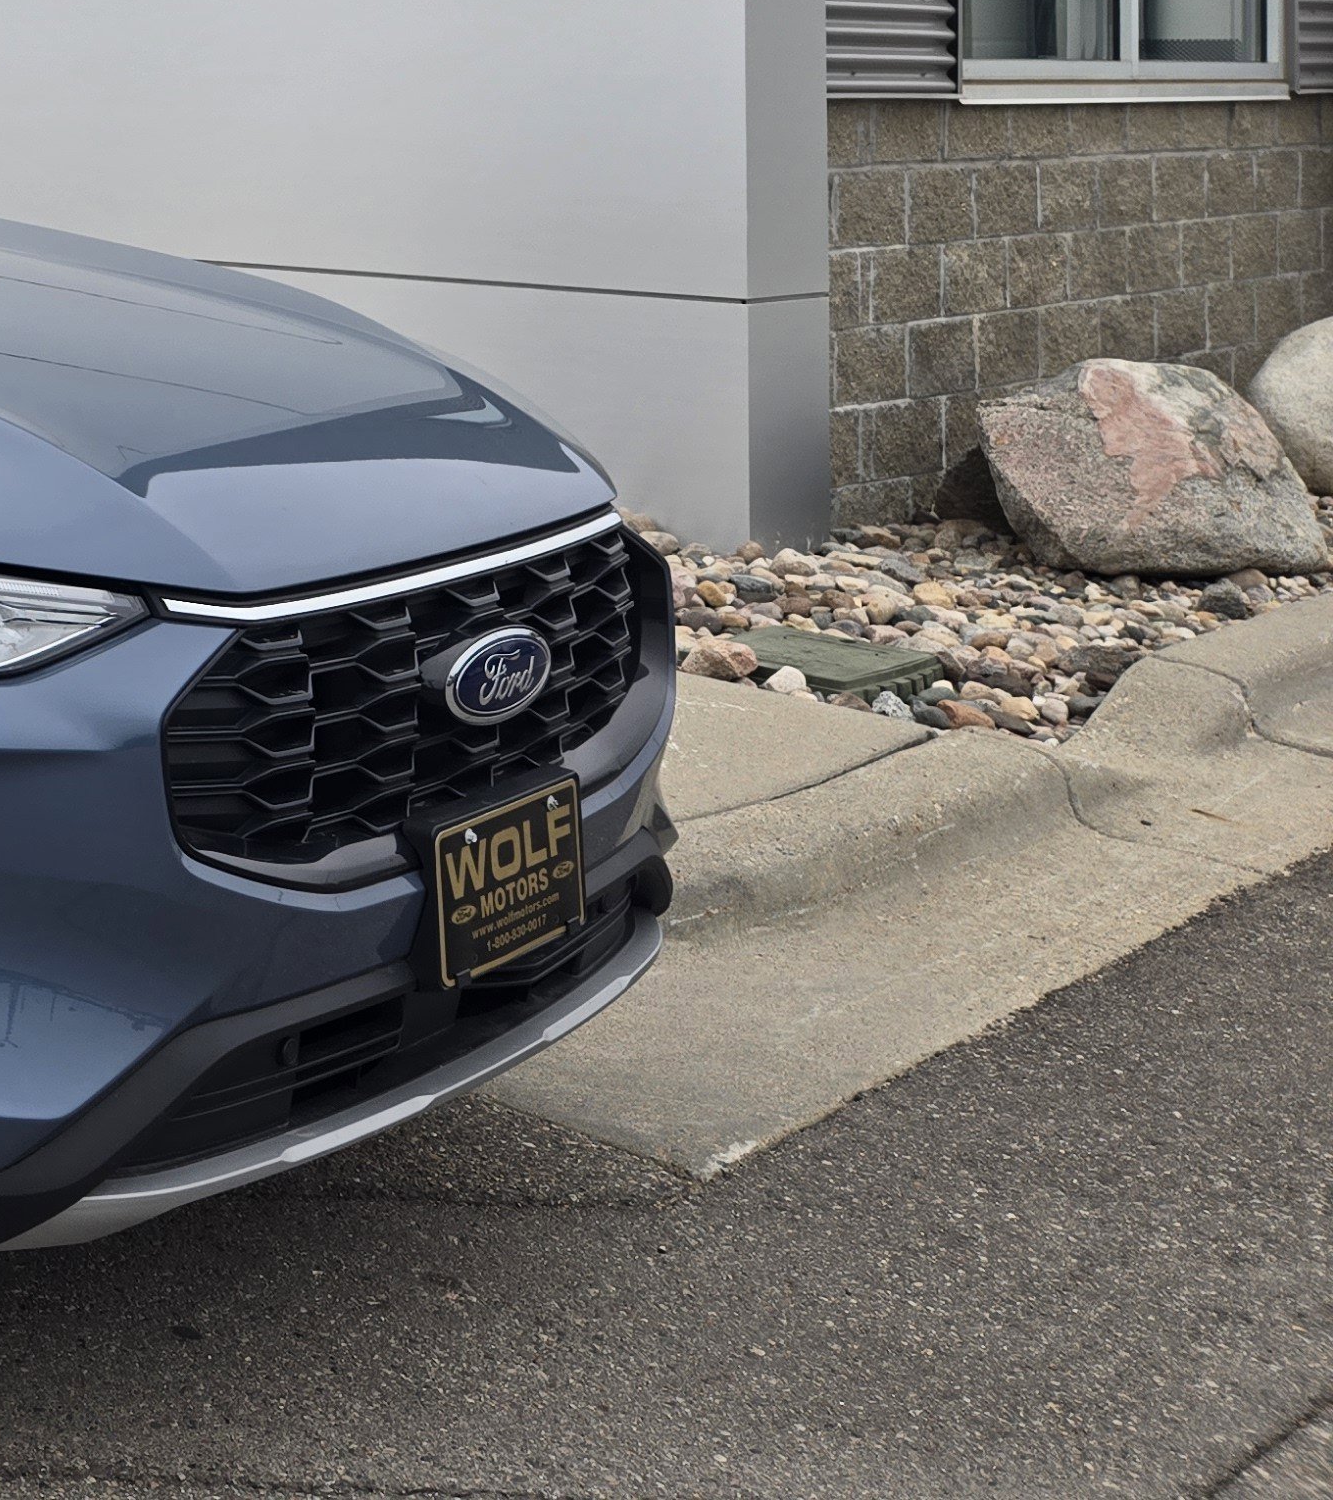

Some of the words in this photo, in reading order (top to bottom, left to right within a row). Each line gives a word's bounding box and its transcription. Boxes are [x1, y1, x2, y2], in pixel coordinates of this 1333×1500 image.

[479, 650, 536, 706] Ford
[445, 804, 571, 900] WOLF
[472, 892, 560, 940] www.wolfmotors.com
[480, 868, 549, 919] MOTORS
[486, 914, 547, 952] 1-800-830-0017
